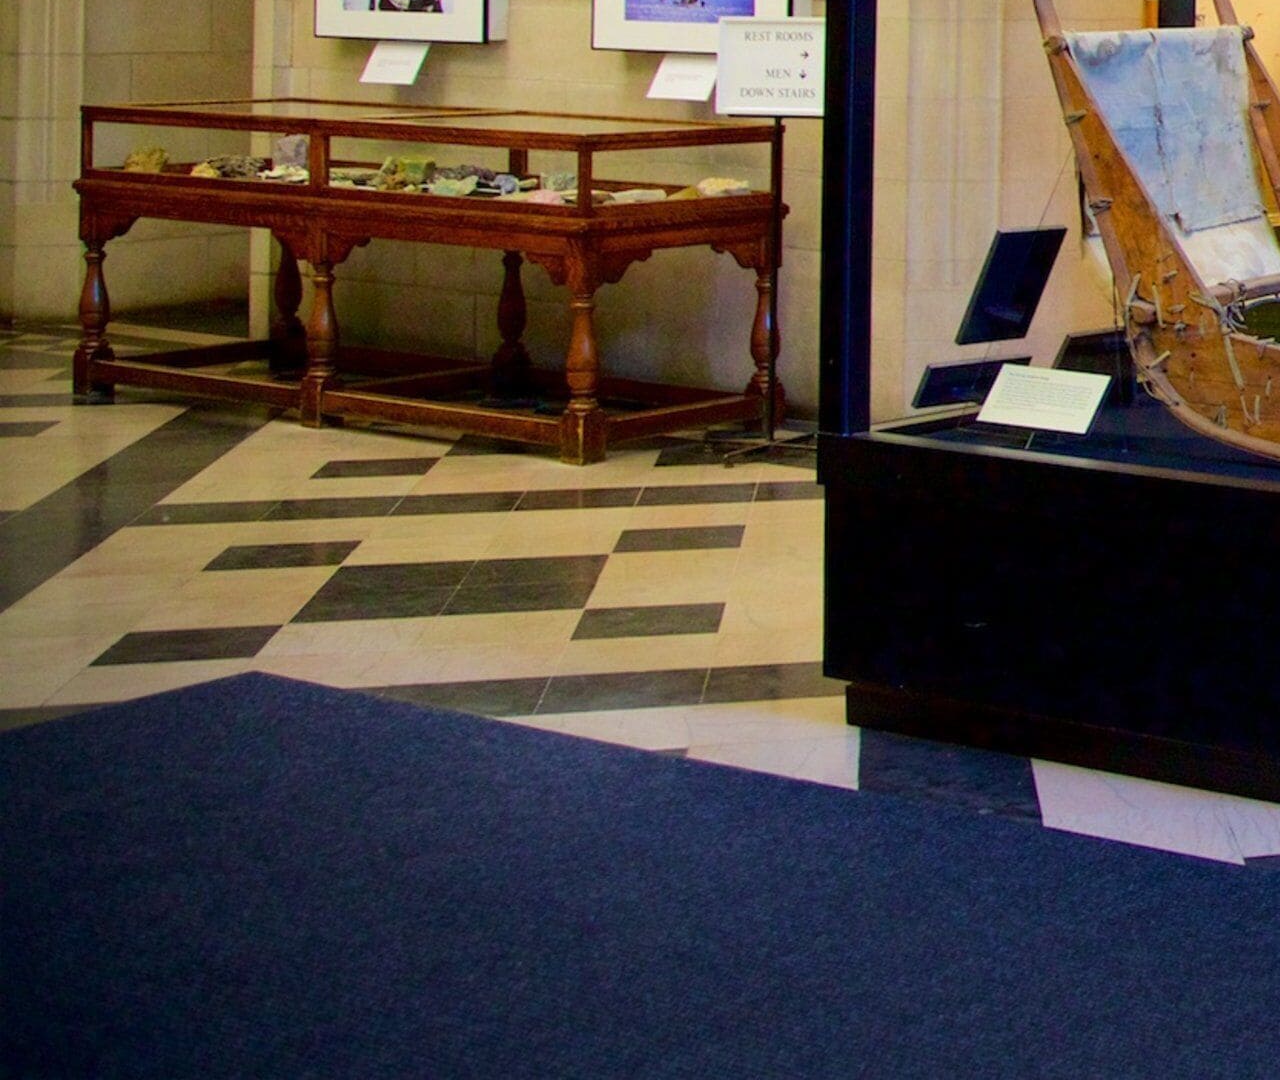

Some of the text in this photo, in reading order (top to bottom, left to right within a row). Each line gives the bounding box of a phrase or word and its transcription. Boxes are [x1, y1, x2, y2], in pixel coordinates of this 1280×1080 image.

[744, 31, 814, 42] REST ROOMS
[765, 69, 791, 79] MEN
[739, 88, 816, 98] DOWN STAIRS
